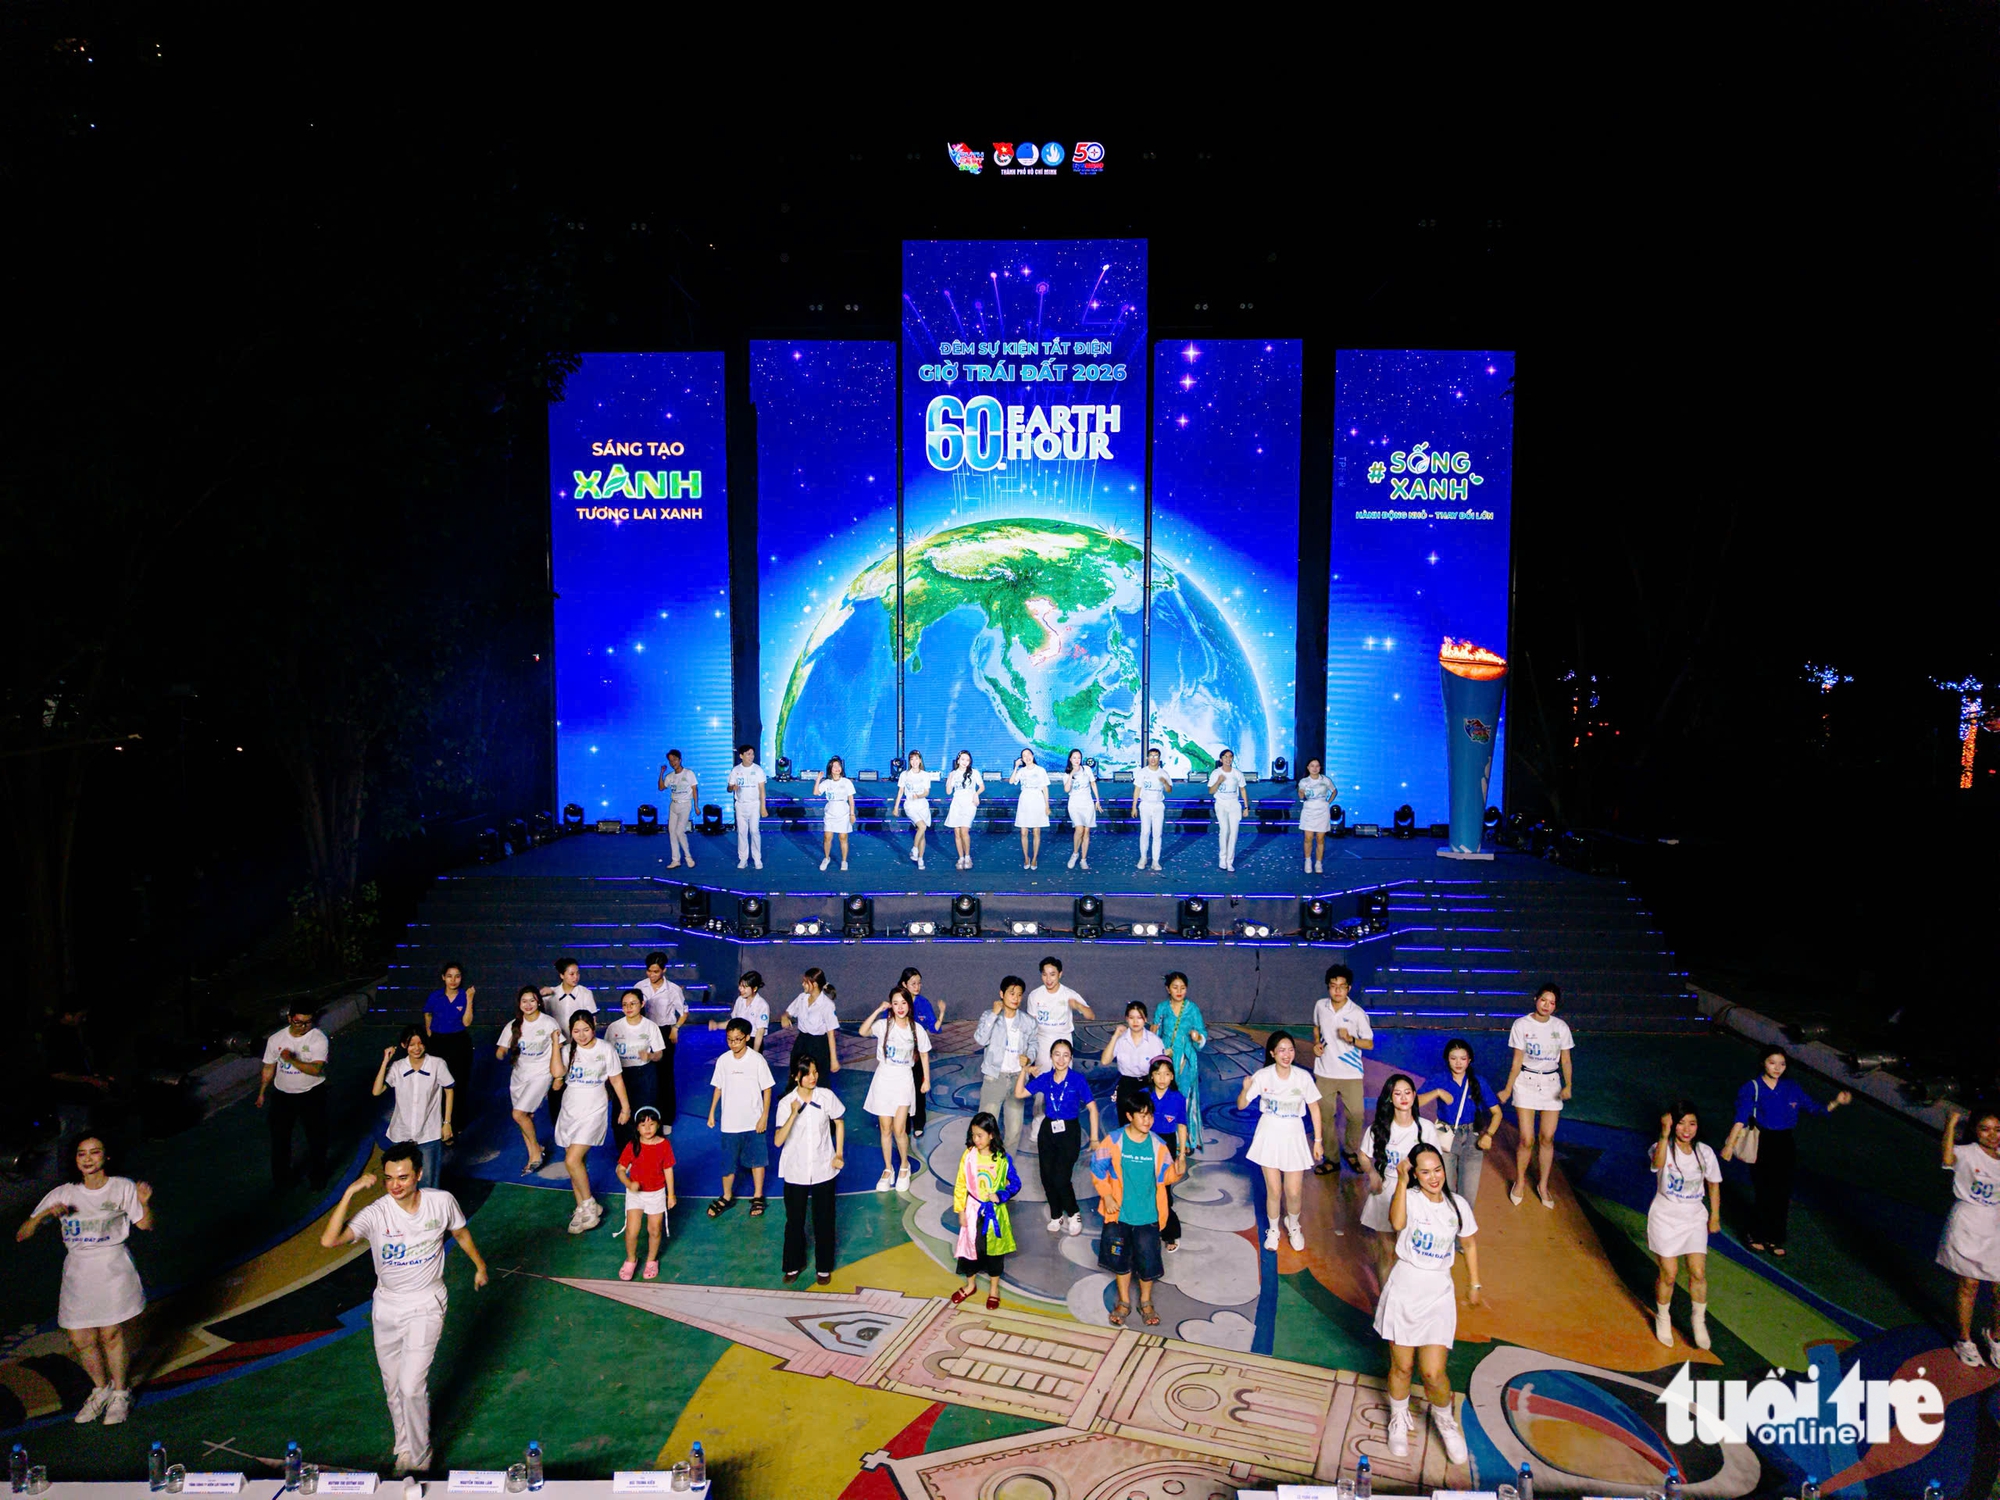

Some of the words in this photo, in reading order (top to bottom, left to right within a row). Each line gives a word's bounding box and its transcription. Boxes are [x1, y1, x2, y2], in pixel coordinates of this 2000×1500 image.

[939, 339, 975, 355] ĐÊM
[978, 340, 1001, 358] SỰ
[1003, 339, 1038, 358] KIỆN
[1074, 339, 1111, 358] ĐIỆN
[918, 360, 958, 381] GIỜ
[963, 360, 1015, 381] TRÁI
[1020, 358, 1067, 381] ĐẤT
[1072, 363, 1127, 381] 2026
[1007, 405, 1121, 433] EARTH
[592, 439, 643, 456] SÁNG
[647, 442, 684, 460] TẠO
[1007, 432, 1114, 460] HOUR
[573, 464, 702, 499] XANH
[1390, 477, 1469, 500] XANH
[576, 506, 629, 520] TƯƠNG
[633, 508, 657, 519] LAI
[660, 508, 703, 519] XANH
[1355, 510, 1381, 519] HÀNH
[1382, 510, 1407, 521] ĐỘNG
